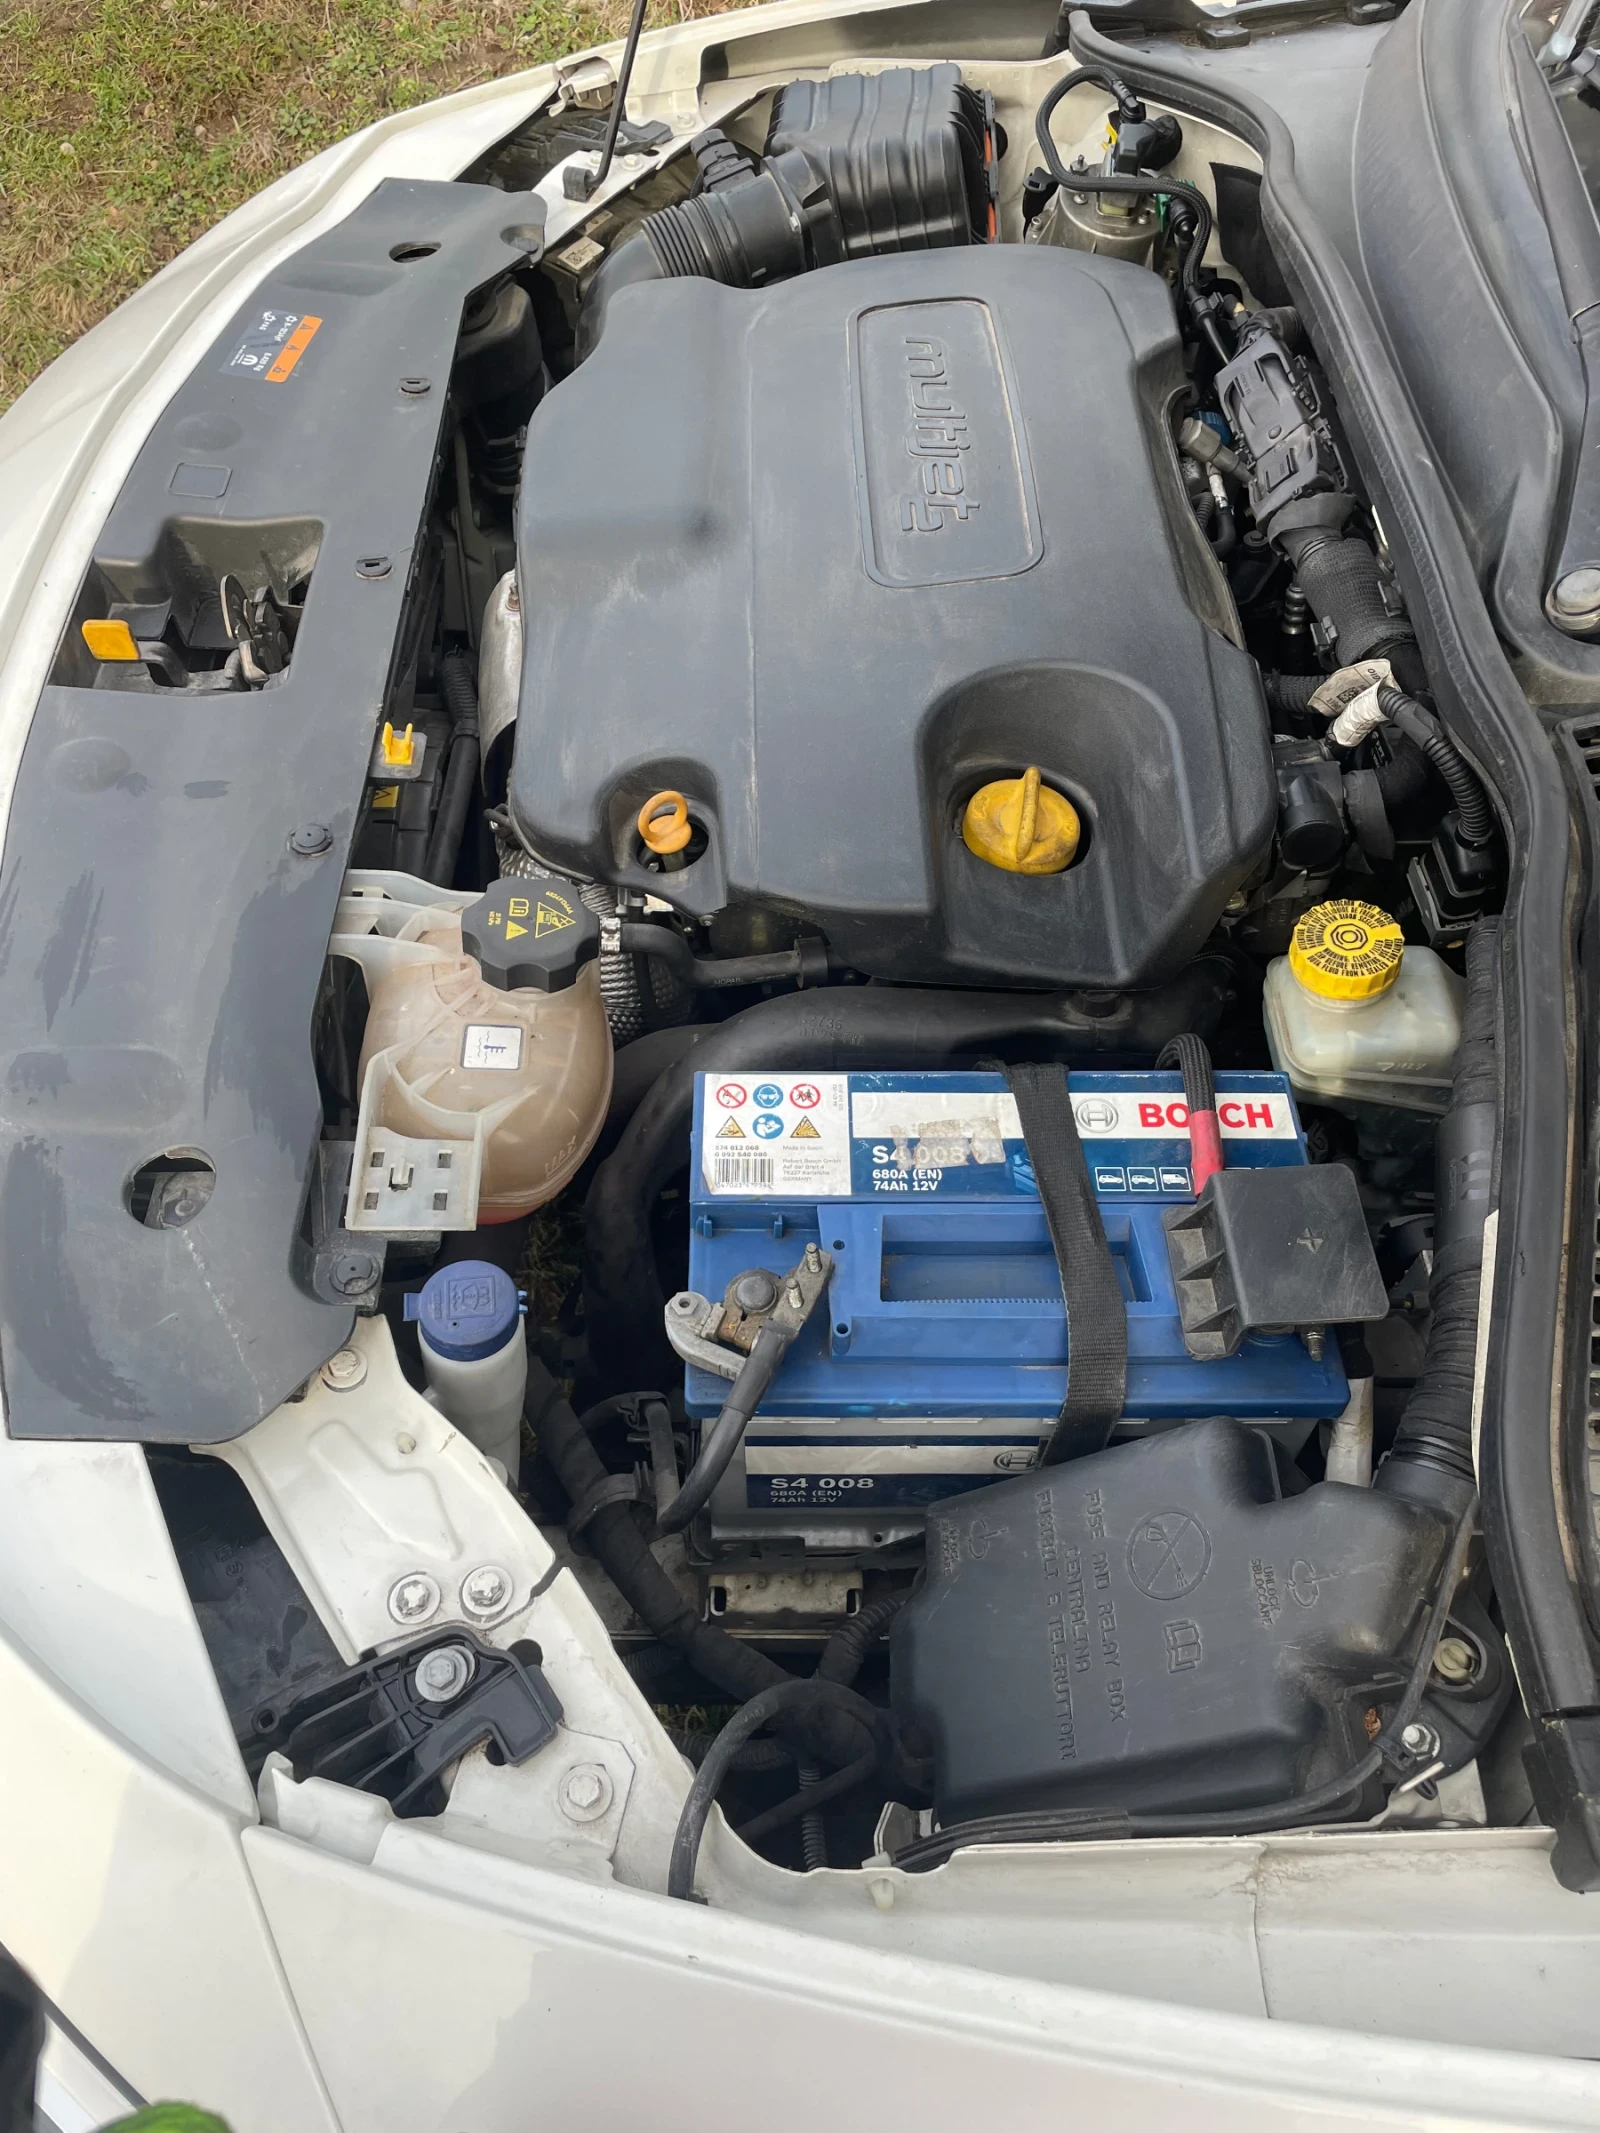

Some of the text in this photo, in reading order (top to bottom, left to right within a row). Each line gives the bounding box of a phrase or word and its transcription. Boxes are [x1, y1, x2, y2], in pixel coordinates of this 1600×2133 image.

[1359, 908, 1377, 920] FREIN
[1315, 951, 1327, 960] CAP
[1325, 957, 1348, 969] BEFORE
[1351, 957, 1381, 970] REMOVING
[1352, 952, 1371, 962] CLEAN
[1321, 963, 1339, 975] FLUID
[1341, 969, 1359, 977] FROM
[1367, 962, 1389, 975] SEALED
[1138, 1102, 1274, 1129] BOCH
[872, 1145, 966, 1163] S4 008
[872, 1168, 943, 1181] 680A (EN)
[872, 1180, 939, 1191] 74Ah 12V
[770, 1477, 875, 1489] S4 008
[811, 1489, 843, 1497] (EN)
[1251, 1558, 1273, 1626] SBLOCCARE
[1263, 1565, 1281, 1612] UNLOCK
[1065, 1545, 1092, 1673] CENTRALINA
[1085, 1488, 1127, 1722] FUSE AND RELAY BOX
[1036, 1488, 1077, 1760] FUSIBILI E TELERUTTORI
